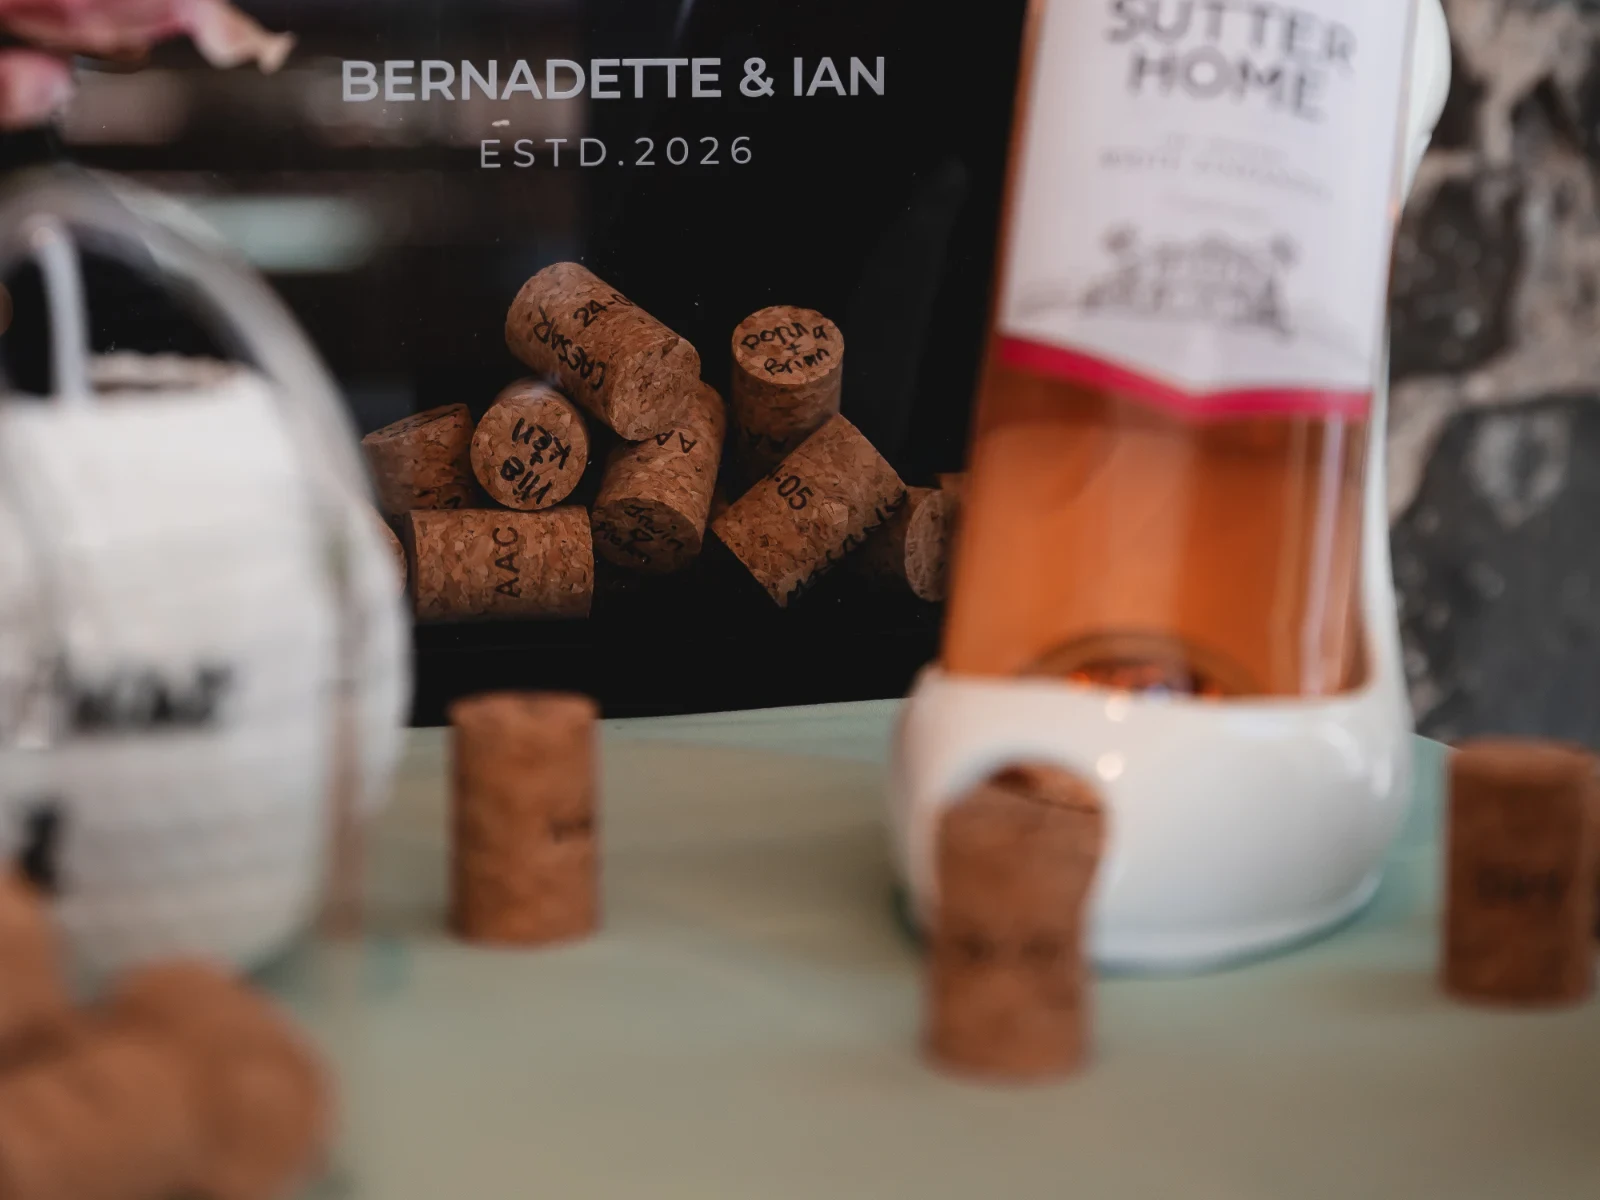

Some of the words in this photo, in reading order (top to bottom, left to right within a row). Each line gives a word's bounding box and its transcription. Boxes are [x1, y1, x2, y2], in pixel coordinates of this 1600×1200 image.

[341, 57, 722, 102] BERNADETTE
[738, 56, 775, 98] &
[793, 55, 886, 97] IAN
[1128, 47, 1329, 123] HOME
[491, 526, 521, 598] AAC
